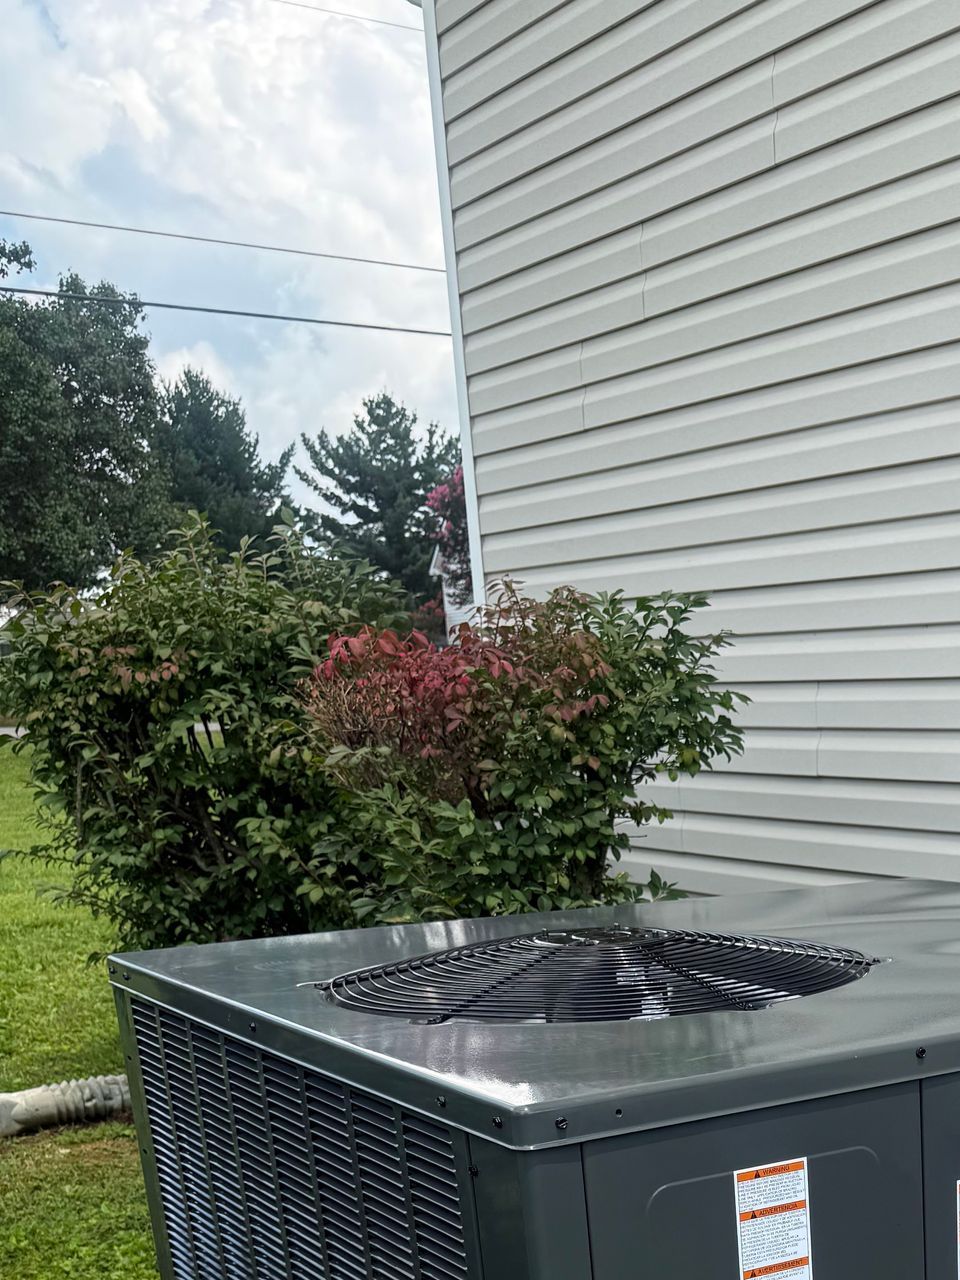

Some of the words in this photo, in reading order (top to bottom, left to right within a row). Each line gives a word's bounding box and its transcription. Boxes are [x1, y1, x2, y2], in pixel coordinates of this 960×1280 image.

[763, 1165, 790, 1176] WARNING
[759, 1203, 798, 1216] ADVERTENCIA
[757, 1259, 804, 1275] AVERTISSEMENT
